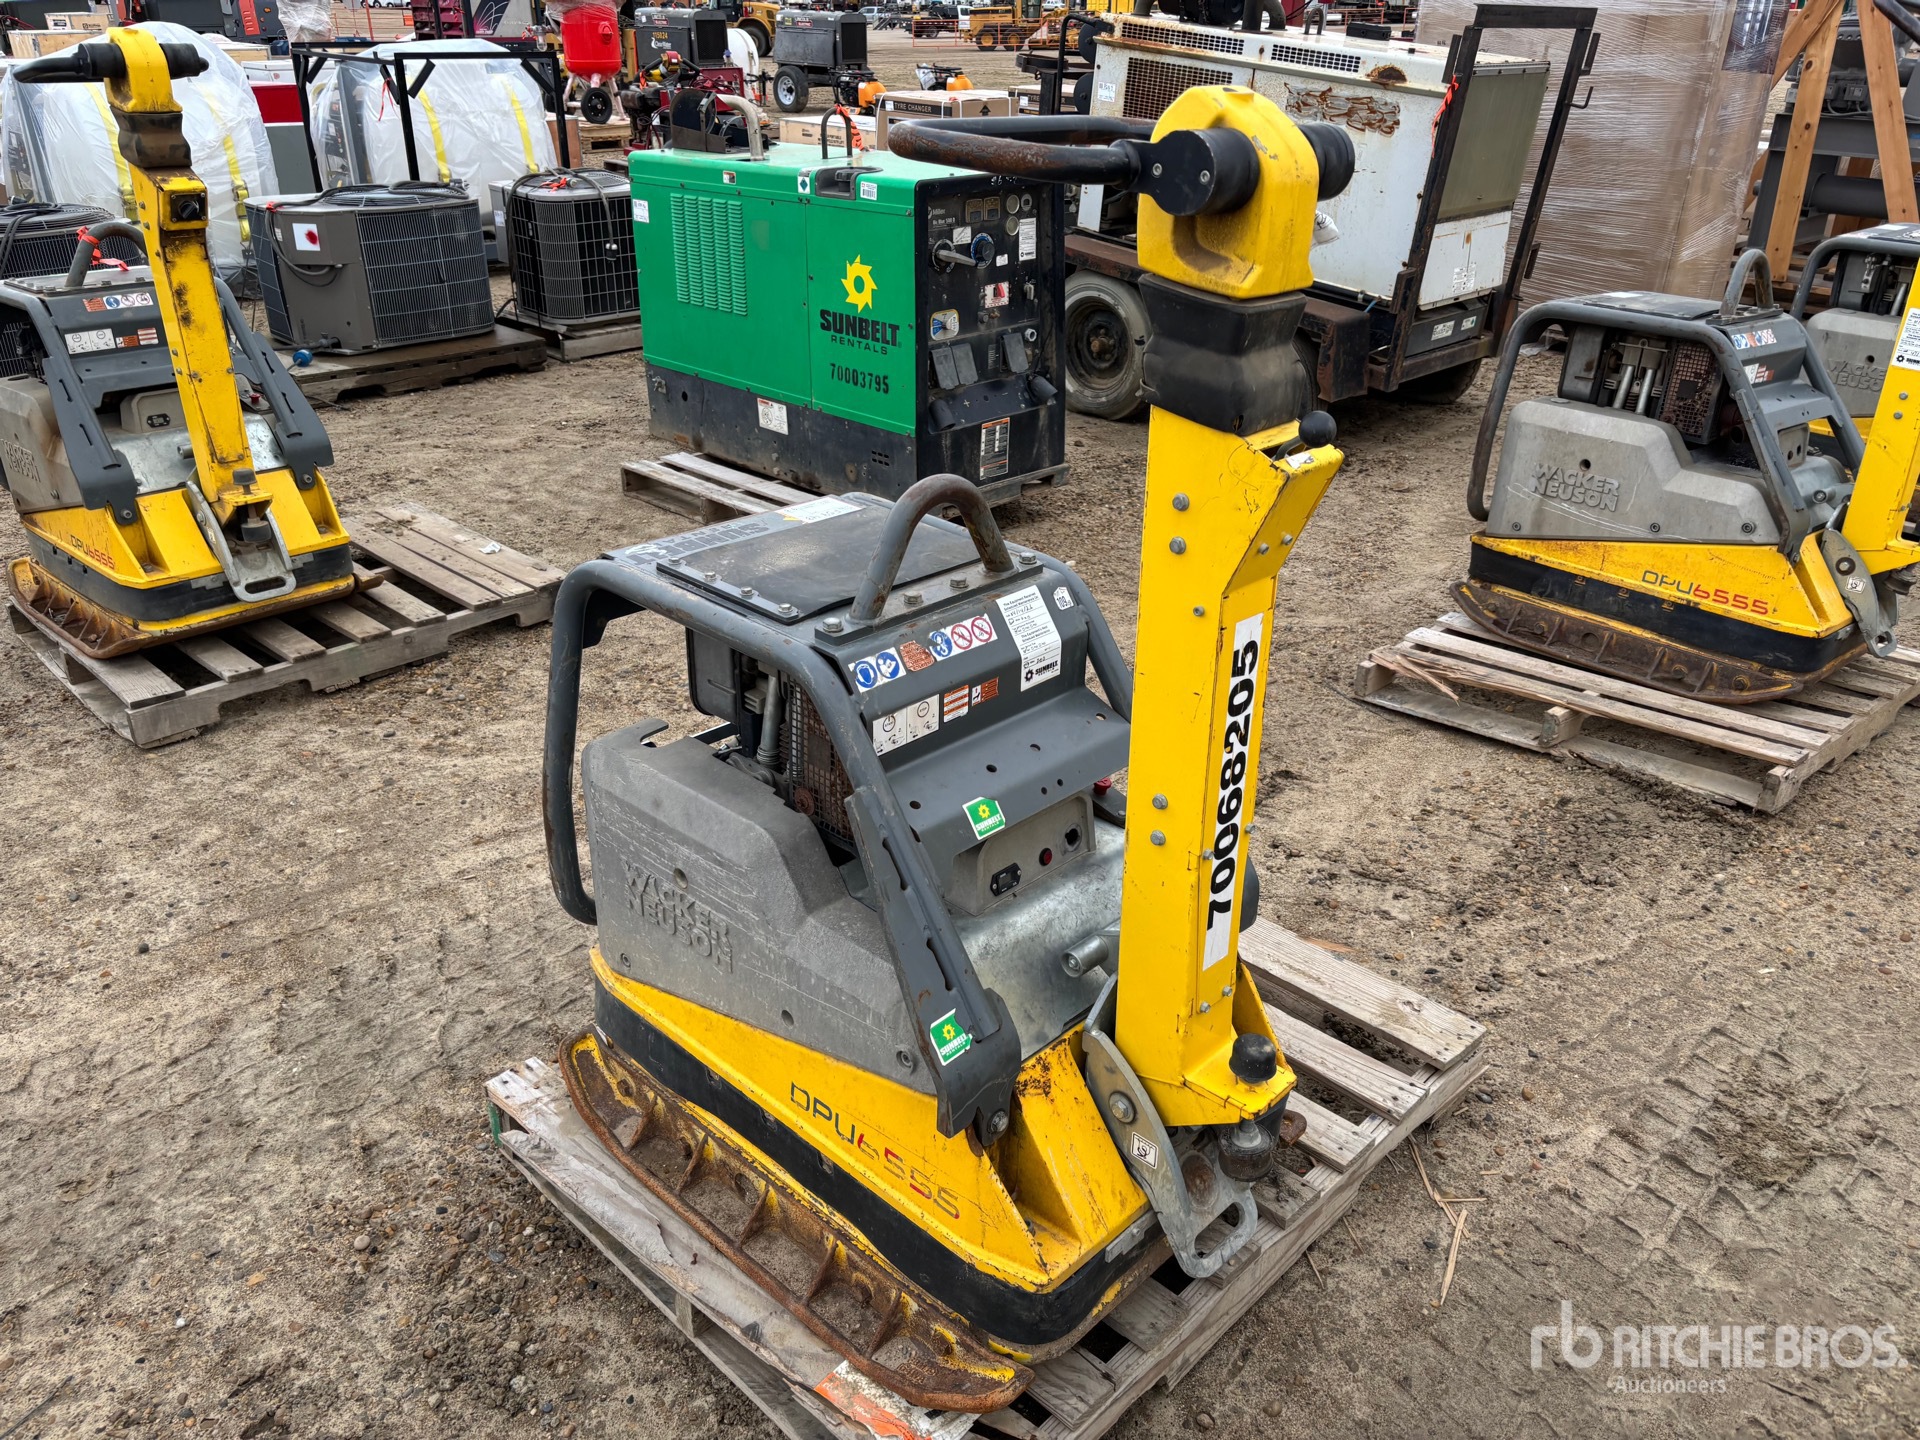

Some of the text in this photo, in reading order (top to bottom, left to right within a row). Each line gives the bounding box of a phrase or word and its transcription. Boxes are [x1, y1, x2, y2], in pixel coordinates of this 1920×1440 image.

[894, 102, 932, 113] TYRE CHANGER
[820, 309, 900, 347] SUNBELT
[831, 334, 888, 355] RENTALS
[830, 362, 889, 395] 70003795
[1827, 359, 1887, 381] WACKE
[1531, 462, 1620, 497] WACKER
[1531, 477, 1619, 513] NEUSON
[70, 534, 115, 570] DPU6555
[1641, 570, 1769, 616] DPU6555
[1035, 660, 1059, 675] SUNBELT
[1206, 638, 1260, 932] 70068205
[975, 813, 1001, 830] SUNBELT
[621, 860, 732, 949] WACKER
[625, 884, 734, 974] NEUSON
[940, 1033, 967, 1056] SUNBELT
[790, 1080, 960, 1220] DPU6555
